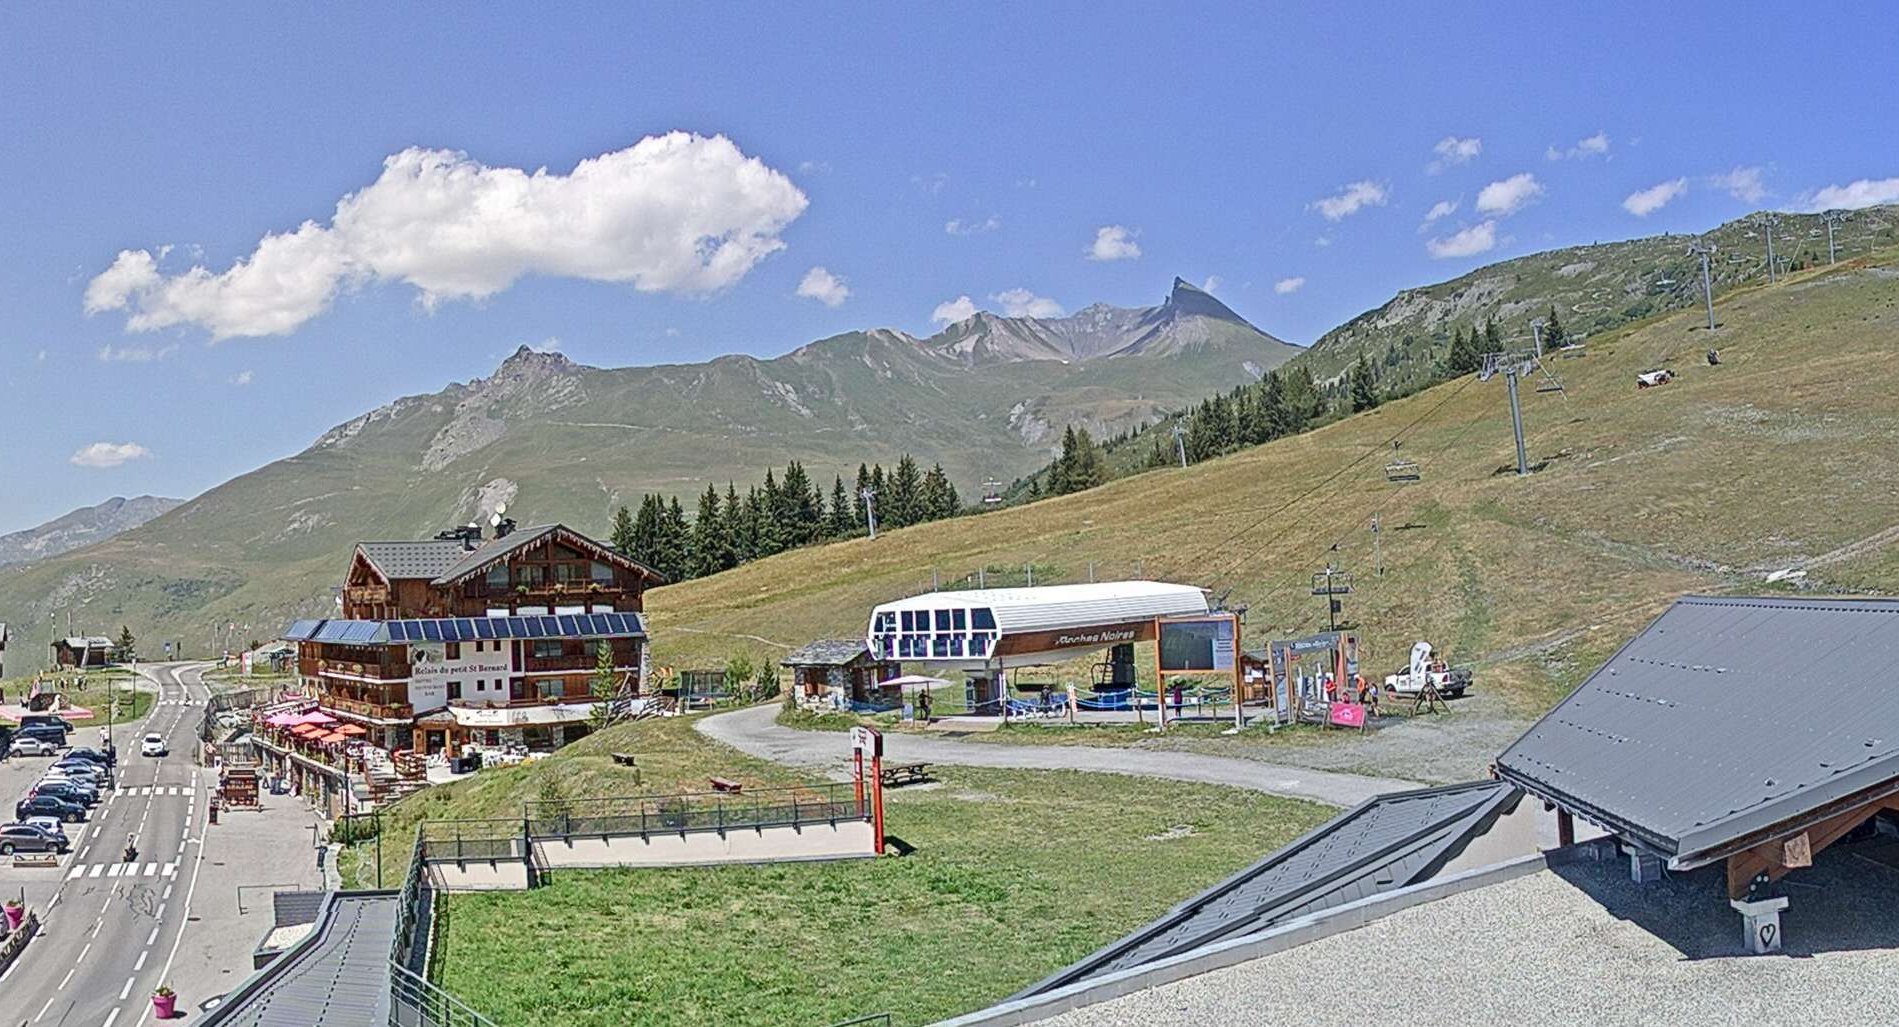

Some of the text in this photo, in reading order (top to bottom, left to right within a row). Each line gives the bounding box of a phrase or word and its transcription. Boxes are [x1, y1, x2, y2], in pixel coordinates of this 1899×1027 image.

[1100, 630, 1135, 642] Noires
[450, 666, 467, 675] petit
[468, 664, 477, 673] St
[478, 663, 508, 672] Bernard
